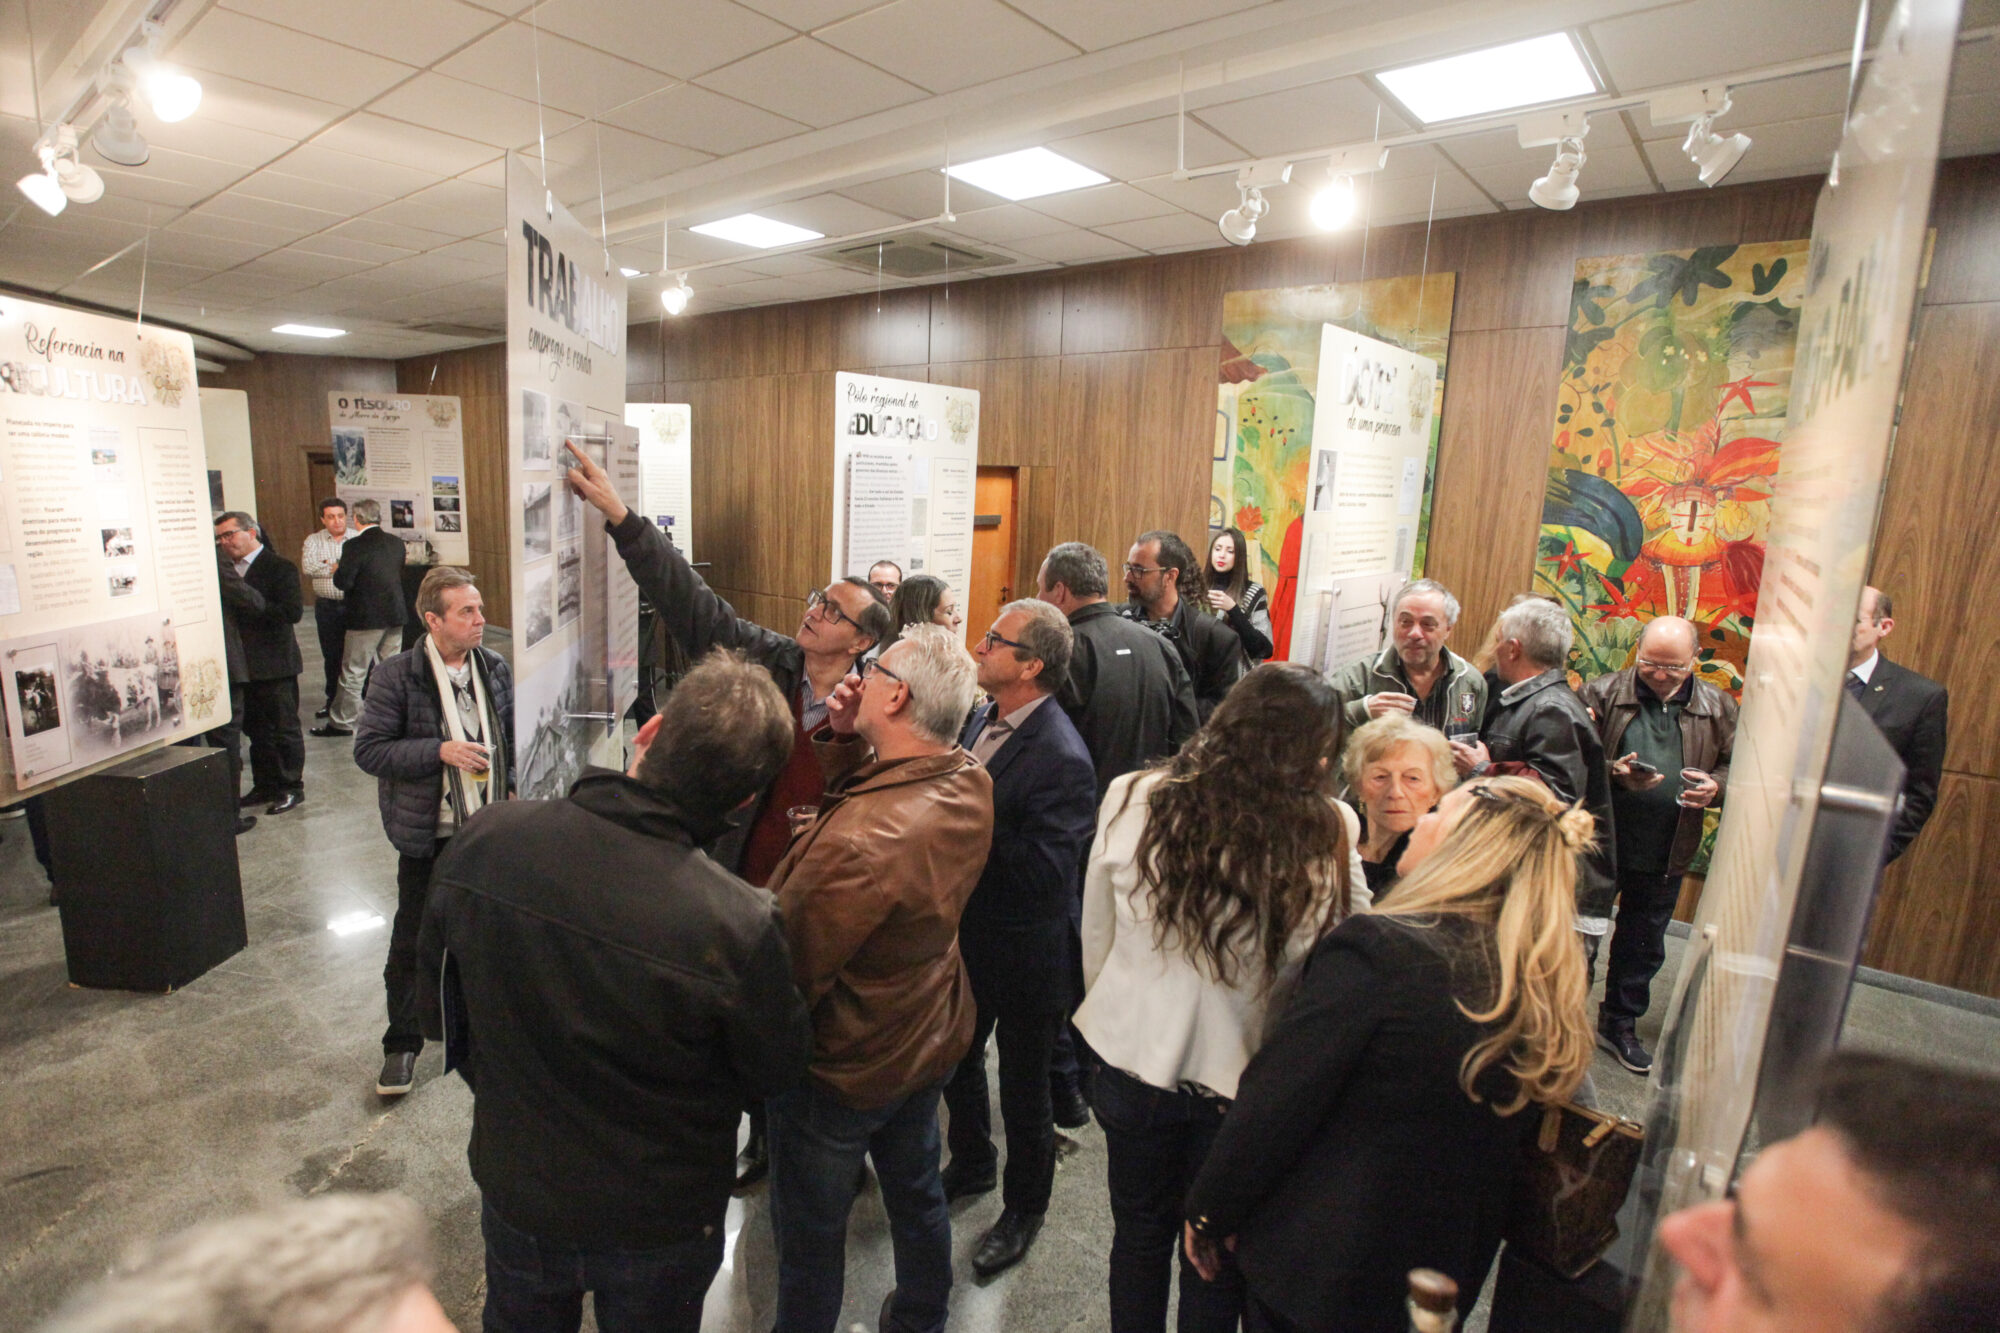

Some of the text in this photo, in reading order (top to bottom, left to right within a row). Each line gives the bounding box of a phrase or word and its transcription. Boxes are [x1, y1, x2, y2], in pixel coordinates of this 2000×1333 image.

[522, 218, 620, 358] TRABALHO
[108, 349, 126, 364] na
[338, 397, 349, 410] O
